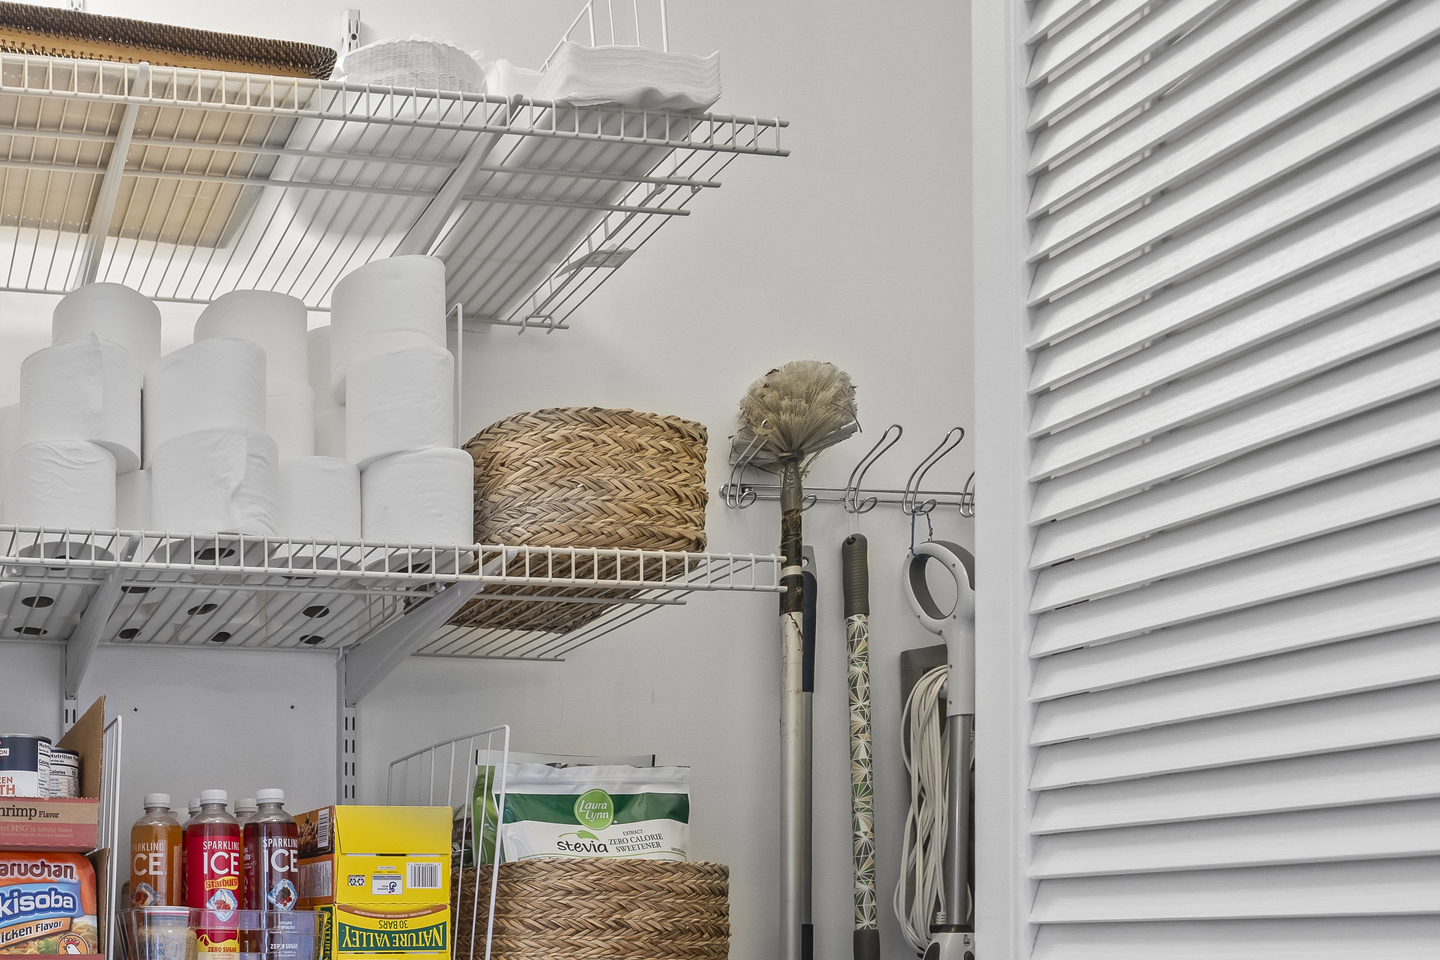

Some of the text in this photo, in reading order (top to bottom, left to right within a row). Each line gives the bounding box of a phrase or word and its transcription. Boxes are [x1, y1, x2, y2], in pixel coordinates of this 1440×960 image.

[579, 799, 607, 813] Laura
[38, 811, 59, 819] Flavor
[585, 809, 609, 820] Lynn
[608, 833, 664, 846] ZERO CALORIE
[556, 841, 609, 853] stevia
[615, 841, 662, 853] SWEETENER
[133, 852, 164, 876] CE
[203, 851, 240, 875] ICE
[263, 849, 298, 873] ICE
[205, 877, 239, 889] Starburs
[35, 919, 63, 933] Flavor
[378, 919, 409, 930] 30 BARS
[342, 925, 444, 948] NATURE VALLEY
